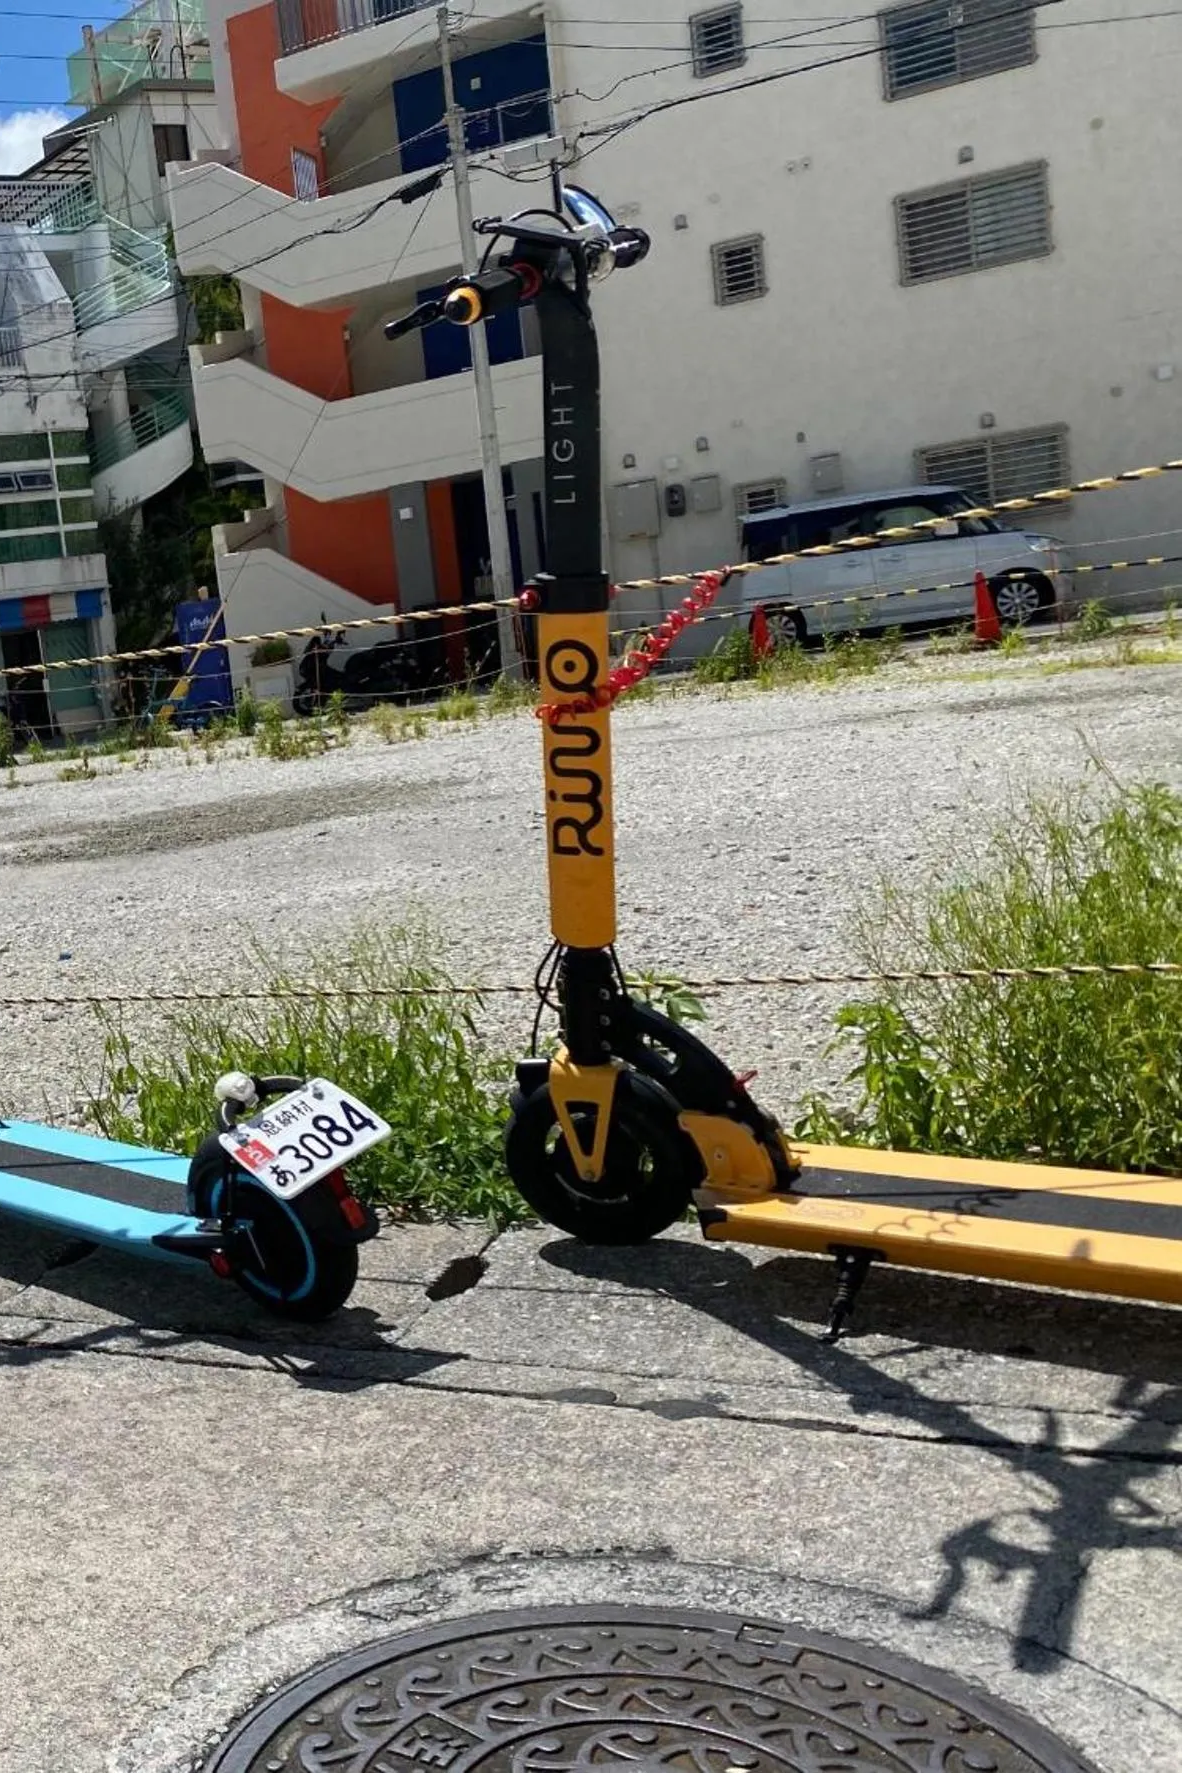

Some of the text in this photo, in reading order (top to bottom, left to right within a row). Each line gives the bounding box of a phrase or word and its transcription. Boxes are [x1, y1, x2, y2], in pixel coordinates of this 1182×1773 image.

[551, 381, 576, 504] LIGHT
[259, 1099, 314, 1138] 恩納村
